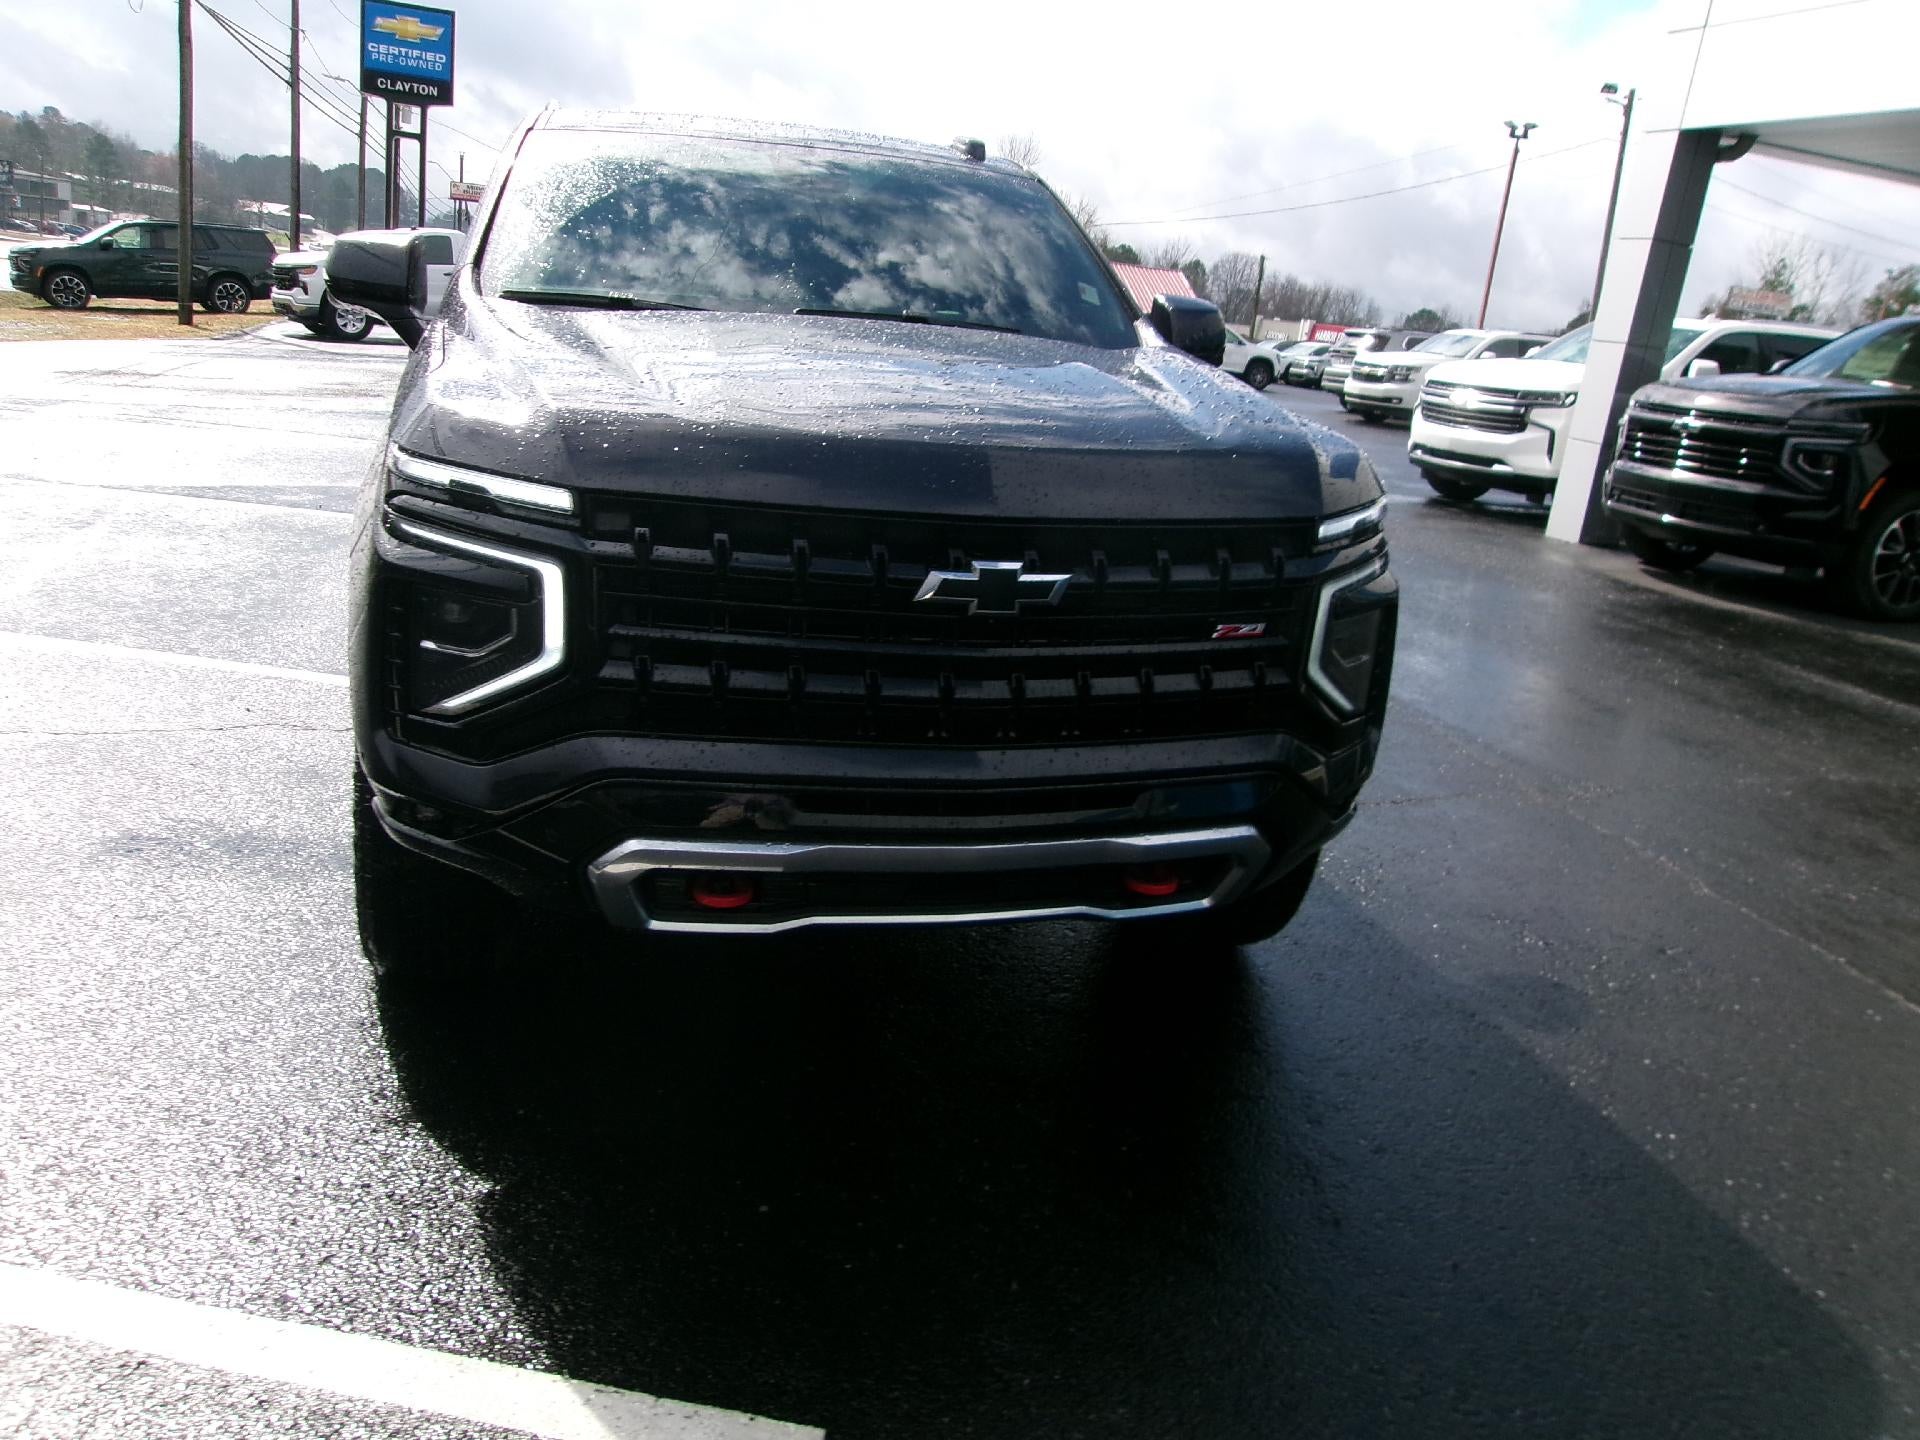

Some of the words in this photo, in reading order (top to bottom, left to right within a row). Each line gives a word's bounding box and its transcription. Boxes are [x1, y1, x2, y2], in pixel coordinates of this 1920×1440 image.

[368, 43, 446, 63] CERTIFIED
[372, 53, 443, 71] PRE-OWNED
[377, 78, 438, 97] CLAYTON
